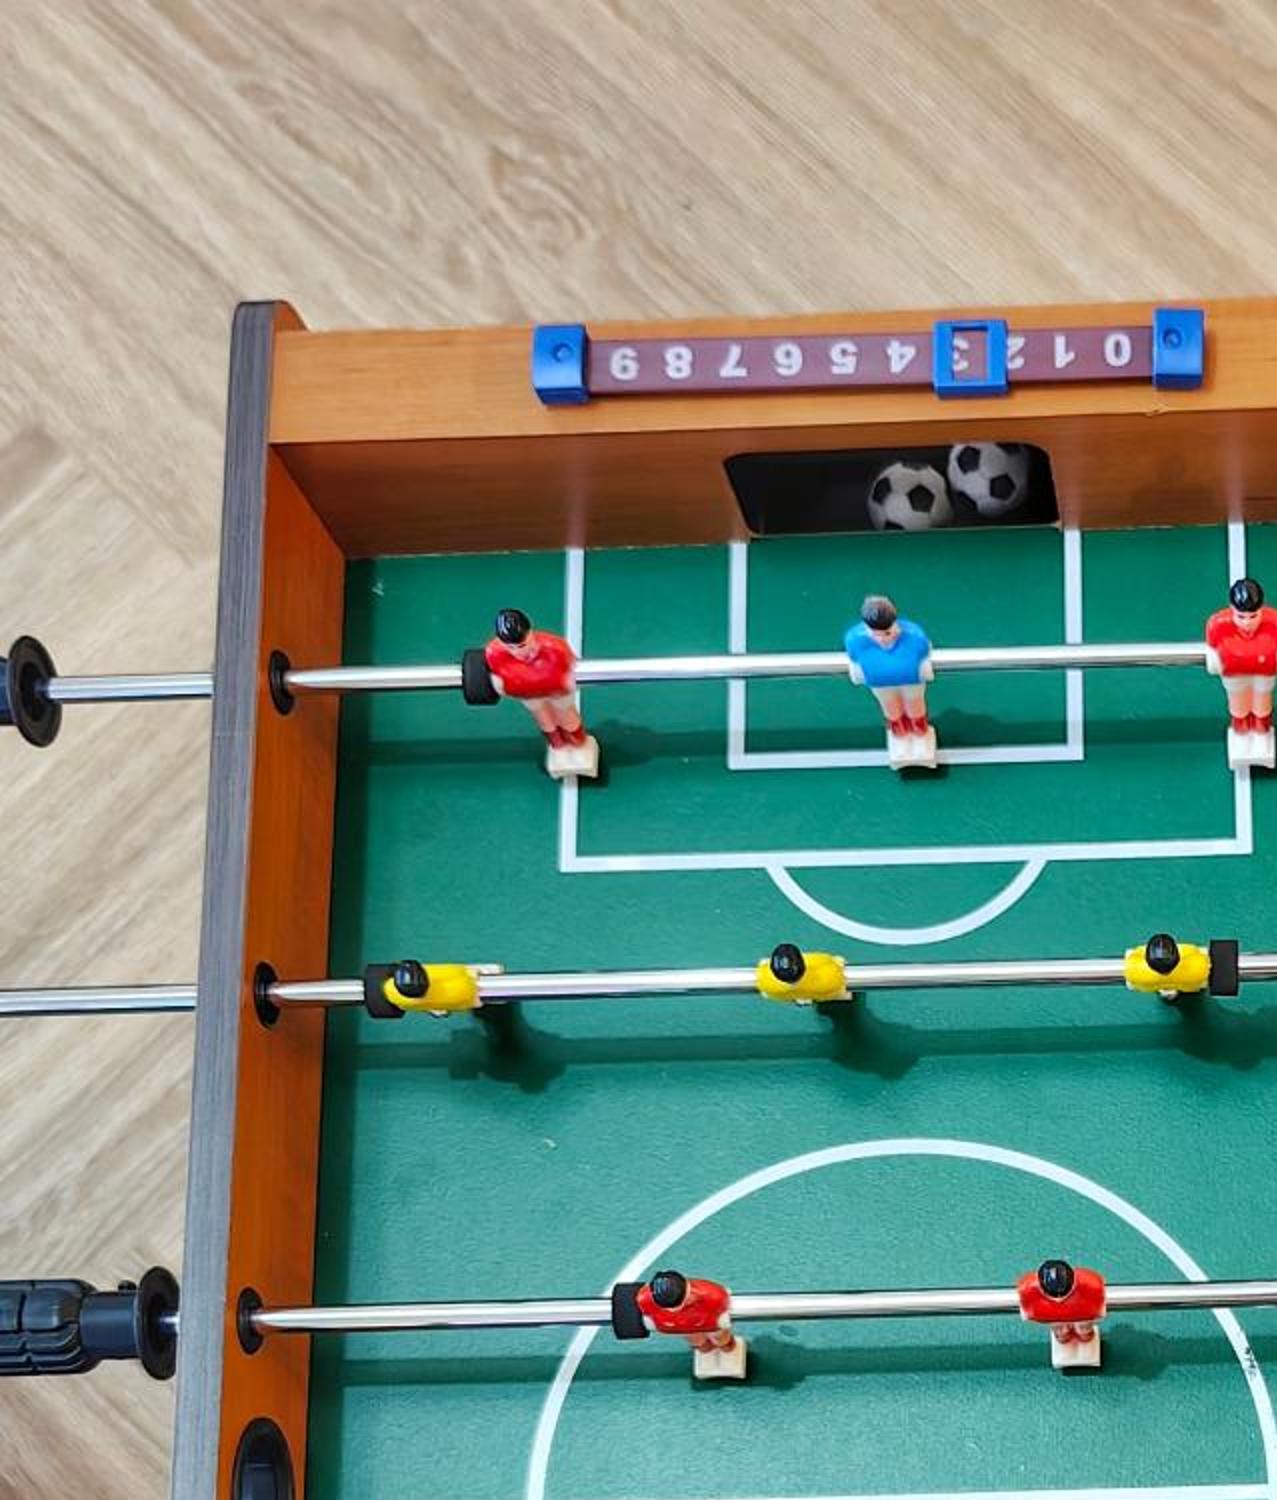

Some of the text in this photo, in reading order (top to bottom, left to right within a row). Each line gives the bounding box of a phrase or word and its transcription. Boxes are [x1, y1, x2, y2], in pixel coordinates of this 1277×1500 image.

[608, 346, 640, 380] 9
[664, 345, 693, 379] 8
[719, 344, 748, 378] 7
[773, 341, 803, 377] 6
[829, 340, 859, 375] 5
[885, 339, 916, 374] 4
[1054, 334, 1074, 368] 1
[1104, 333, 1132, 367] 0
